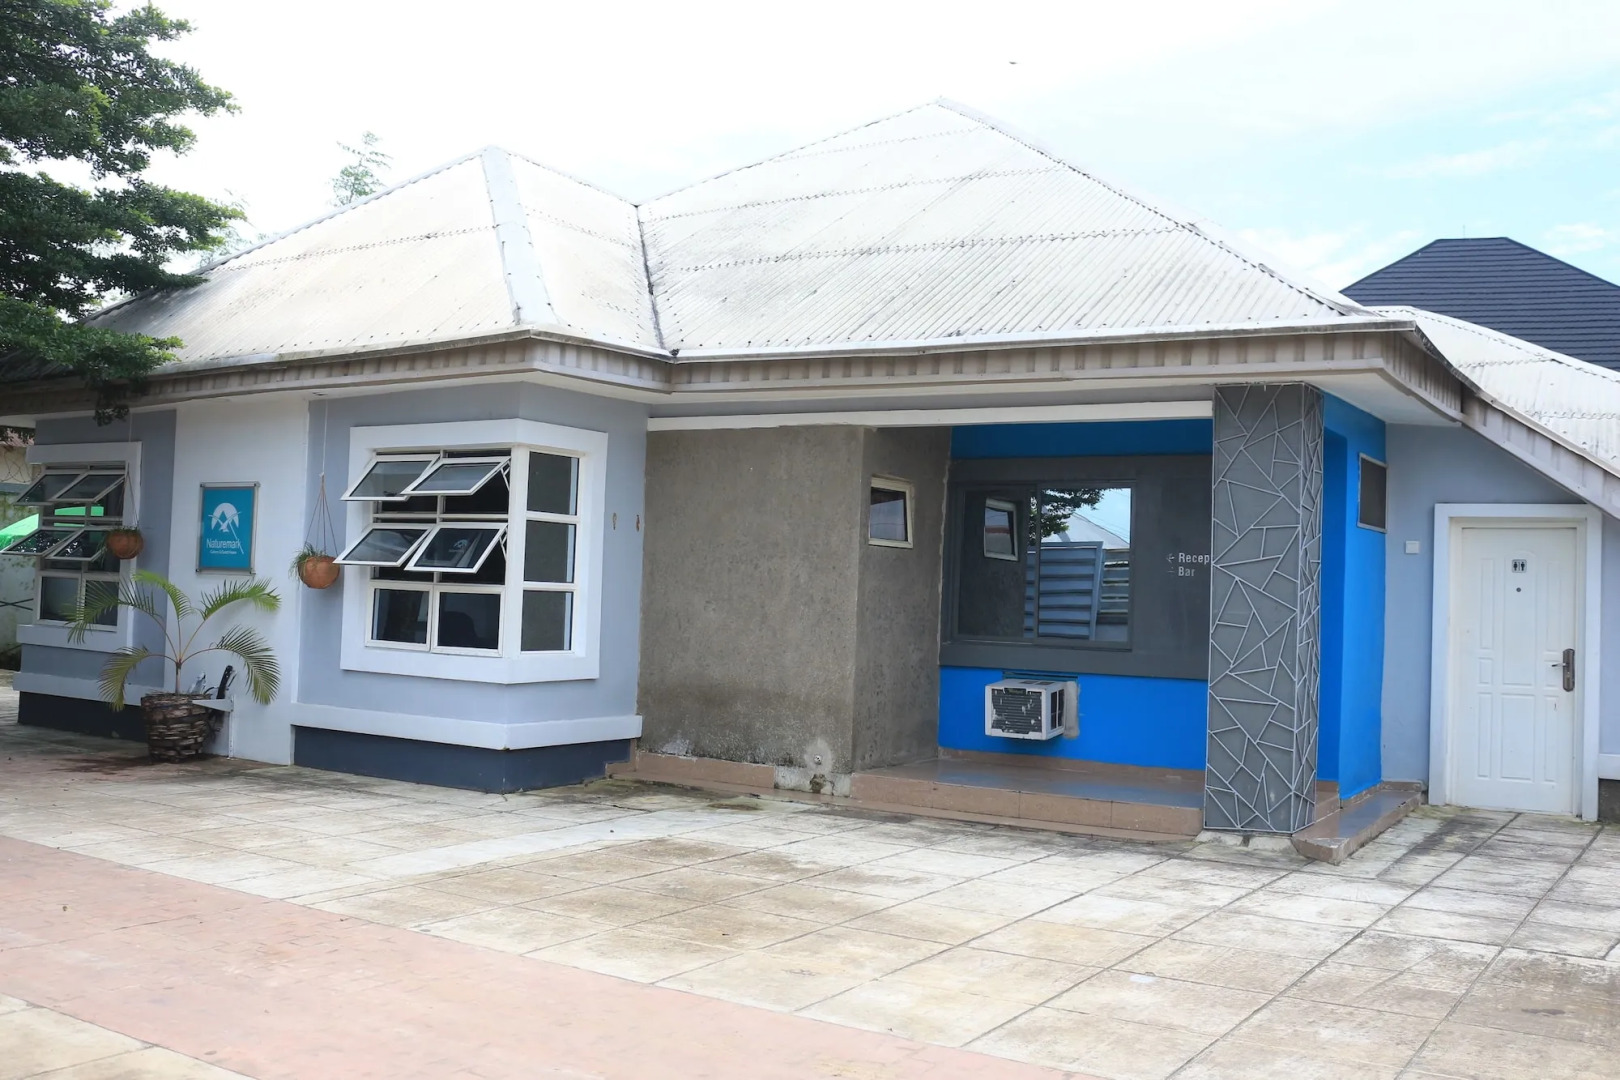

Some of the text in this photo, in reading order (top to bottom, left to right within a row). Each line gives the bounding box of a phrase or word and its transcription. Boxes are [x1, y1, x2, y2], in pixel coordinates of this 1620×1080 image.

[206, 538, 241, 549] Naturemark
[1178, 552, 1210, 565] Recep
[1178, 566, 1196, 577] Bar
